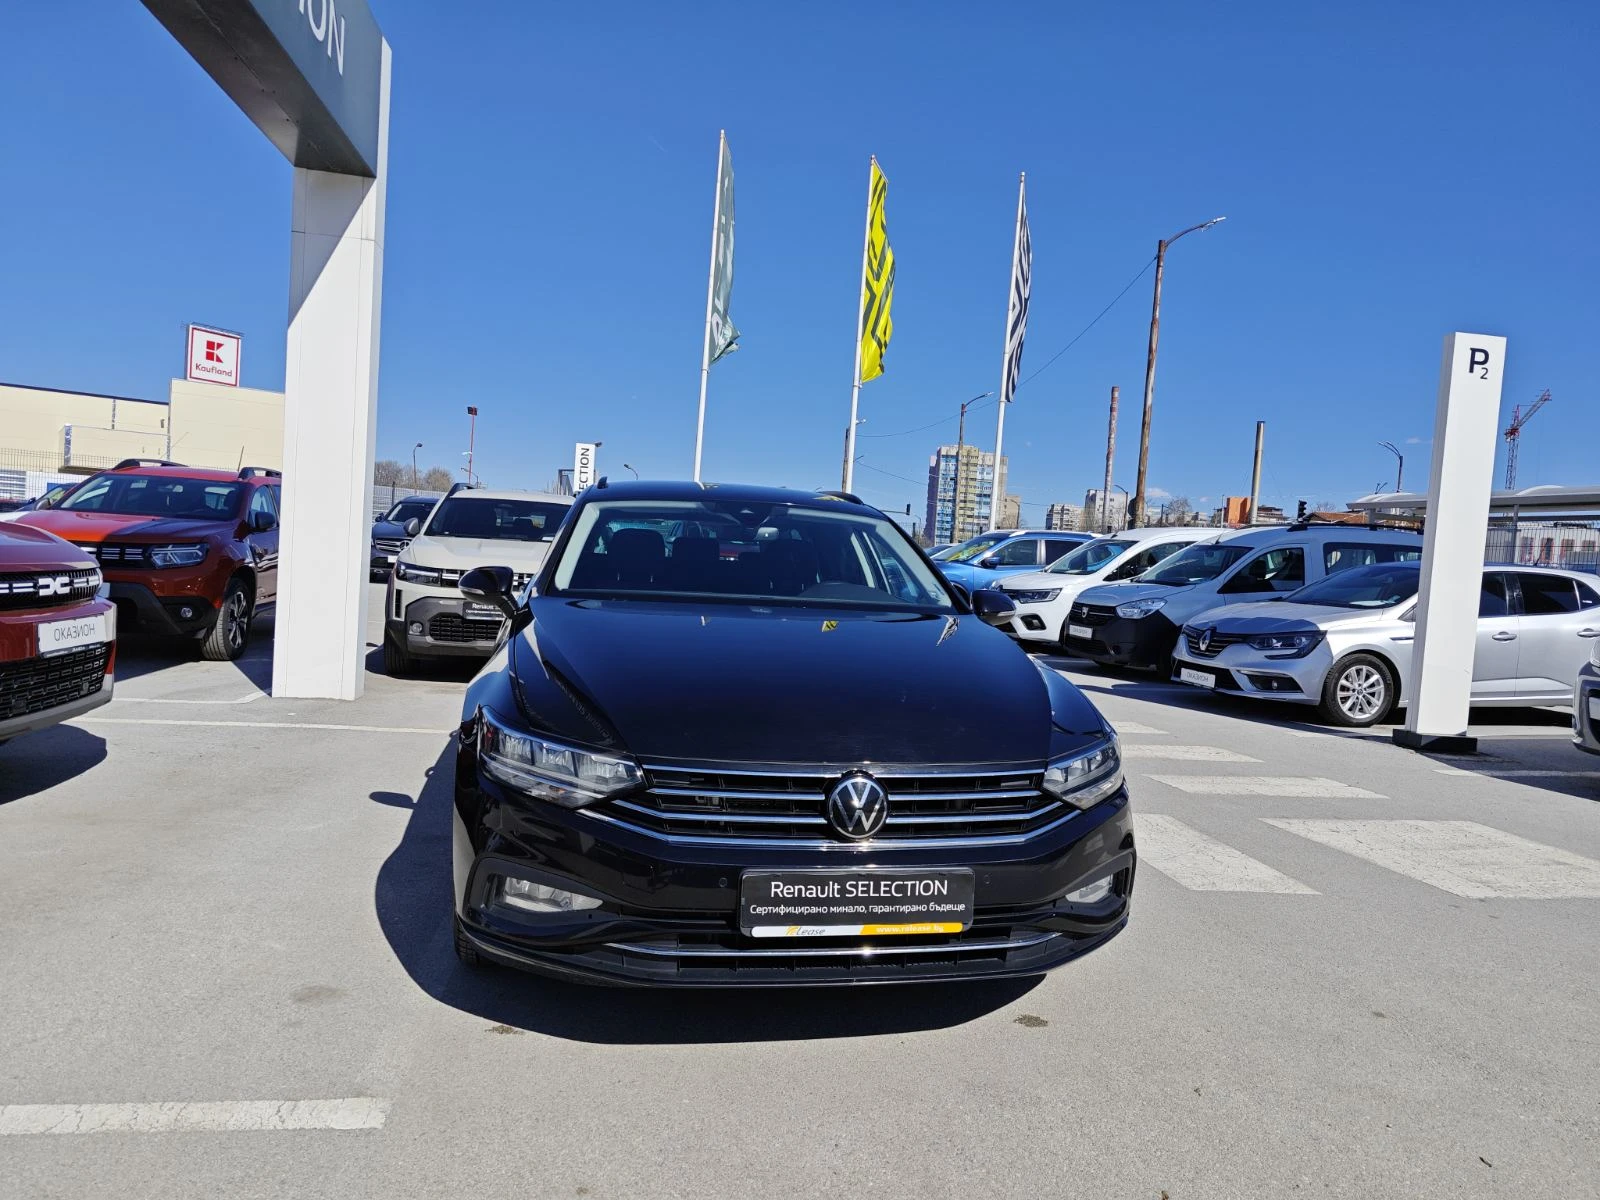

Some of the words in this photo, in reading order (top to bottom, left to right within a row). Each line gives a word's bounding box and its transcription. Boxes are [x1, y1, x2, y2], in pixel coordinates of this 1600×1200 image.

[299, 0, 345, 77] ON
[195, 363, 233, 377] Kaufland
[53, 623, 96, 642] ОКАЗИОН
[770, 881, 841, 898] Renault
[845, 879, 949, 898] SELECTION
[750, 904, 828, 916] Сертифицирано
[829, 904, 867, 914] минало,
[869, 903, 928, 914] гарантирано
[929, 902, 966, 912] бъдеще
